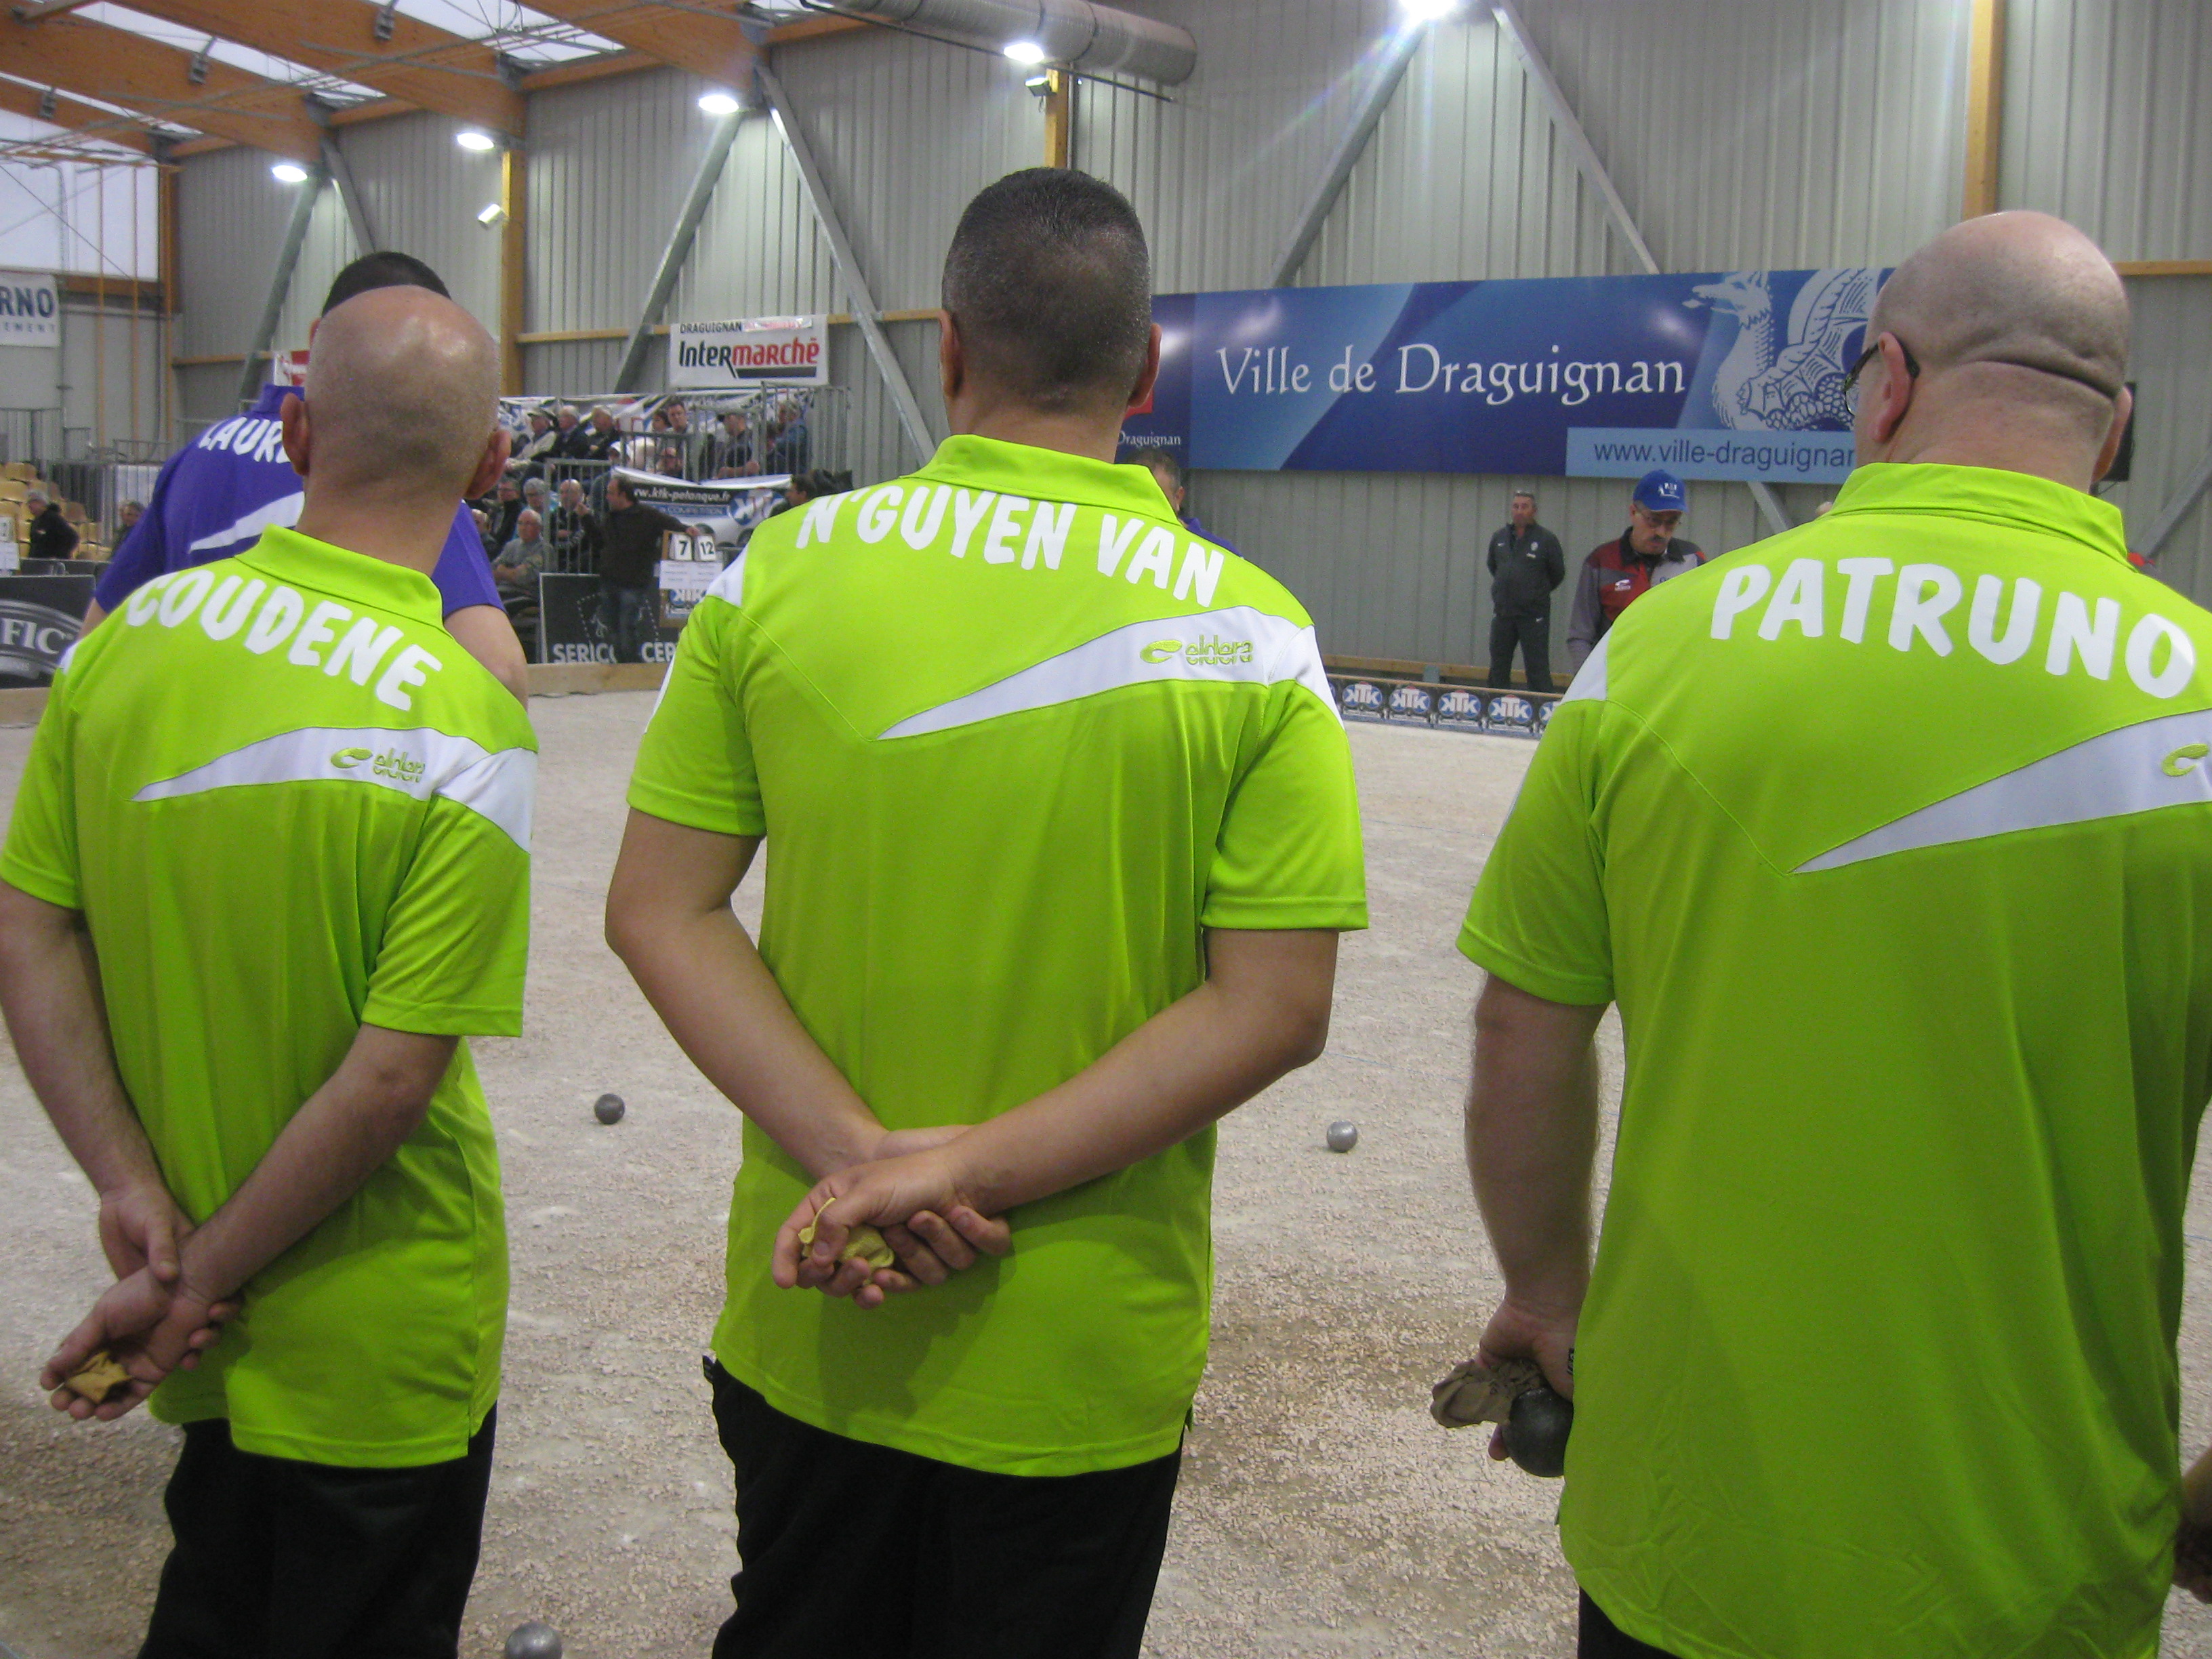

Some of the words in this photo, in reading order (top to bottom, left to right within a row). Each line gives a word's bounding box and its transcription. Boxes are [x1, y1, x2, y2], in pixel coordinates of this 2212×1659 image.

[680, 322, 743, 333] DRAGUIGNAN
[1216, 345, 1312, 394] Ville
[1328, 344, 1377, 394] de
[1395, 342, 1686, 406] Draguignan
[678, 540, 689, 556] 7
[699, 541, 715, 555] 12
[796, 484, 1078, 570] N'GUYEN
[1097, 514, 1224, 608] VAN
[127, 569, 443, 712] COUDENE
[1710, 557, 2196, 699] PATRUNO
